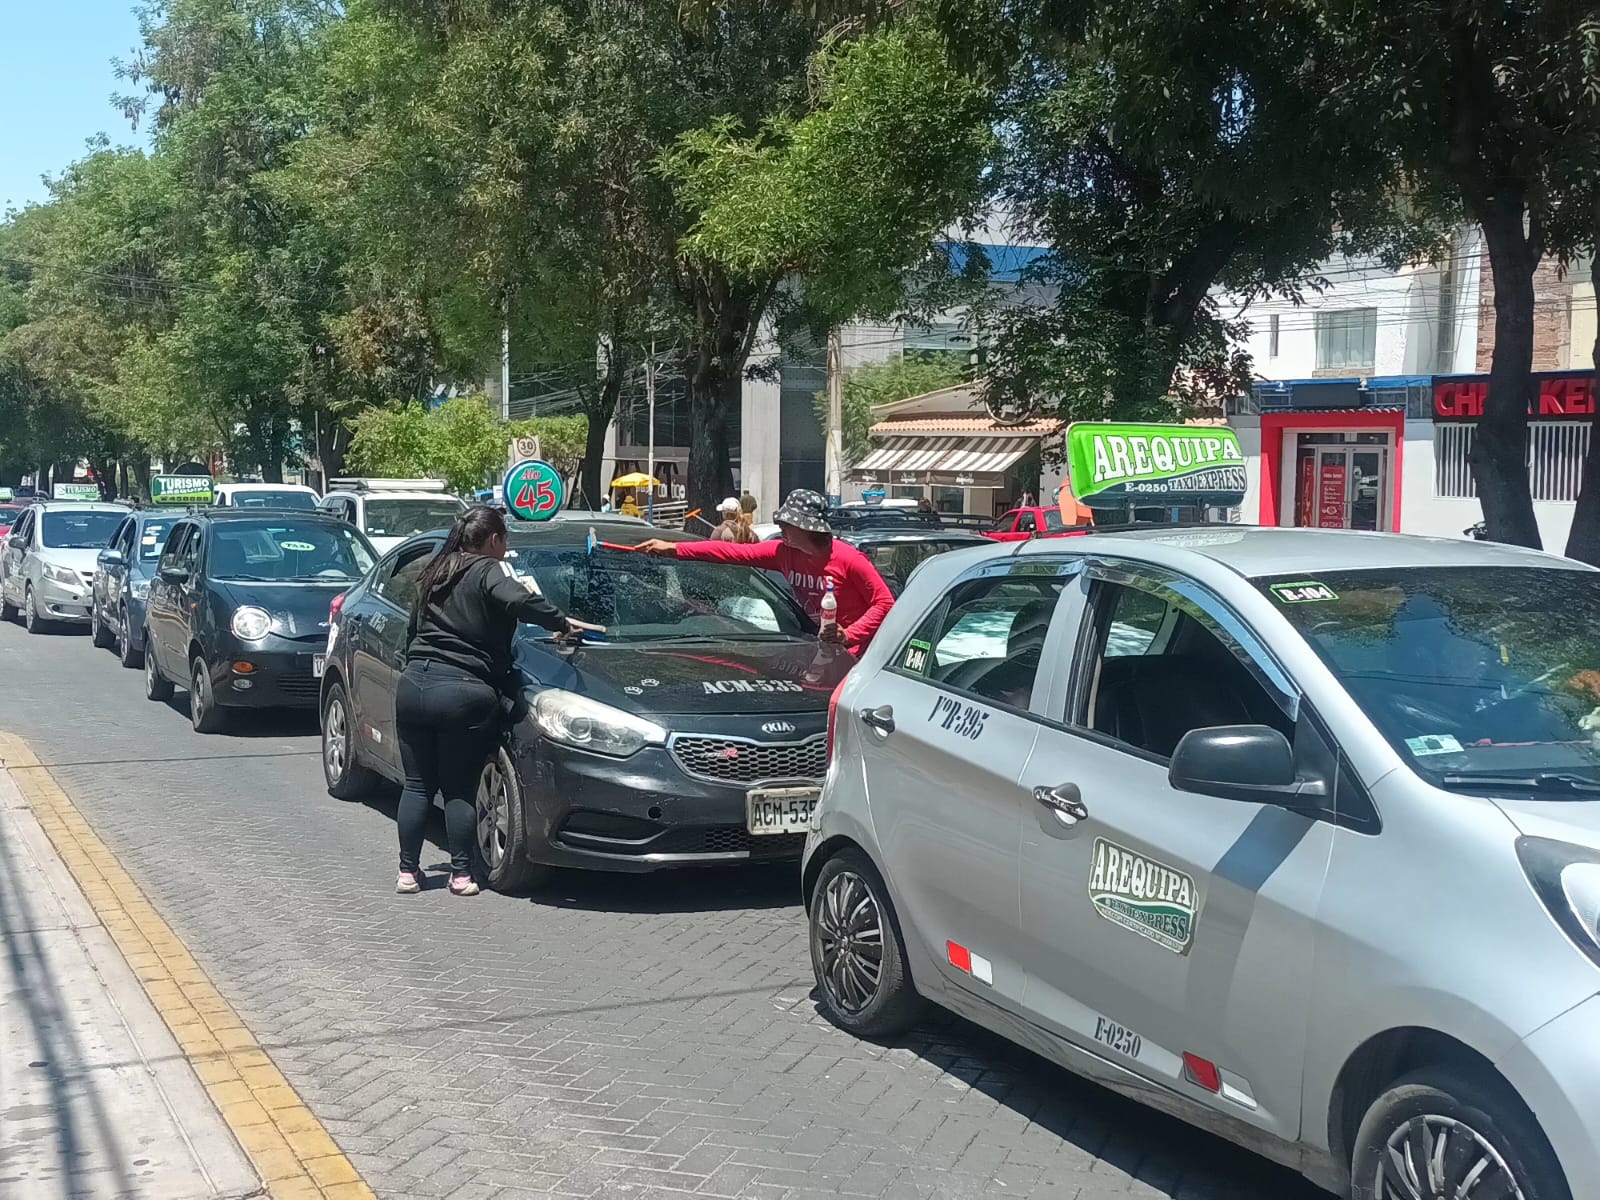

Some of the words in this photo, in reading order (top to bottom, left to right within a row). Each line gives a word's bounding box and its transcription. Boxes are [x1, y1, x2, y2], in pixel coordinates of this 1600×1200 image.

[519, 441, 533, 450] 30
[1093, 434, 1242, 483] AREQUIPA
[160, 478, 209, 490] TURISMO
[1125, 482, 1167, 492] E-0250
[1169, 476, 1194, 490] TAXI
[1196, 468, 1246, 490] EXPRESS
[515, 478, 556, 516] 45
[789, 570, 834, 590] ADIDAS
[702, 680, 803, 694] ACM-535
[766, 721, 792, 732] KIA
[1091, 843, 1191, 906] AREQUIPA
[1131, 908, 1187, 941] EXPRESS
[1094, 1016, 1141, 1058] E-0250
